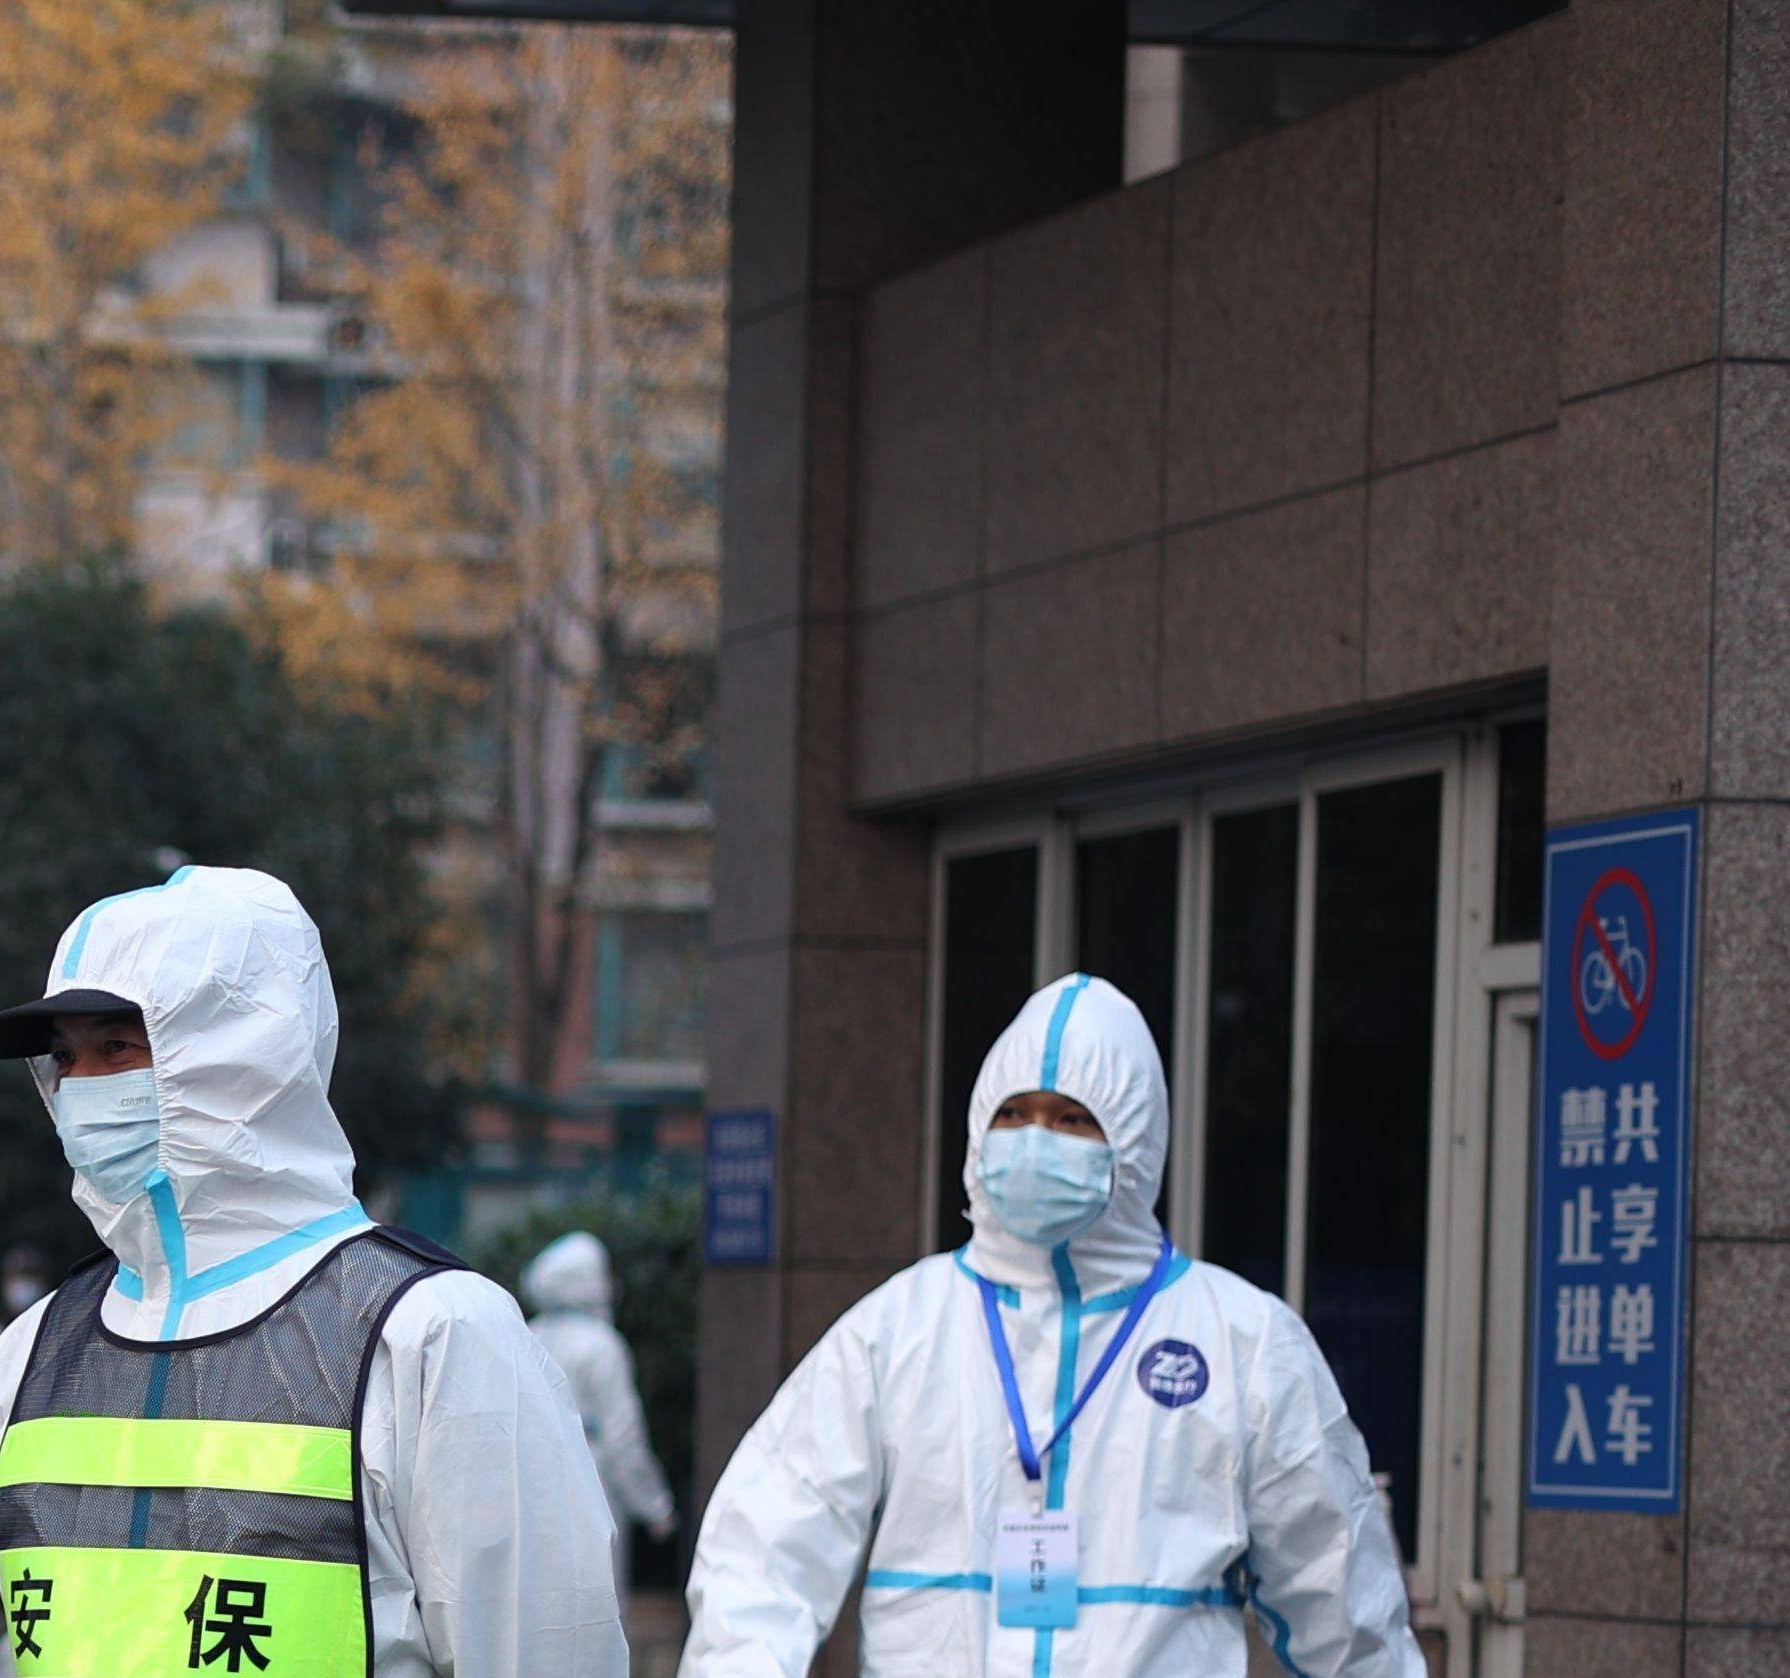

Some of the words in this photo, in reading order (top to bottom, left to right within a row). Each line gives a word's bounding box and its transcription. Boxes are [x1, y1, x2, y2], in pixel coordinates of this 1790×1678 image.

[1553, 1087, 1607, 1464] 禁止进入
[1605, 1083, 1659, 1465] 共享单车
[10, 1568, 273, 1673] 安保
